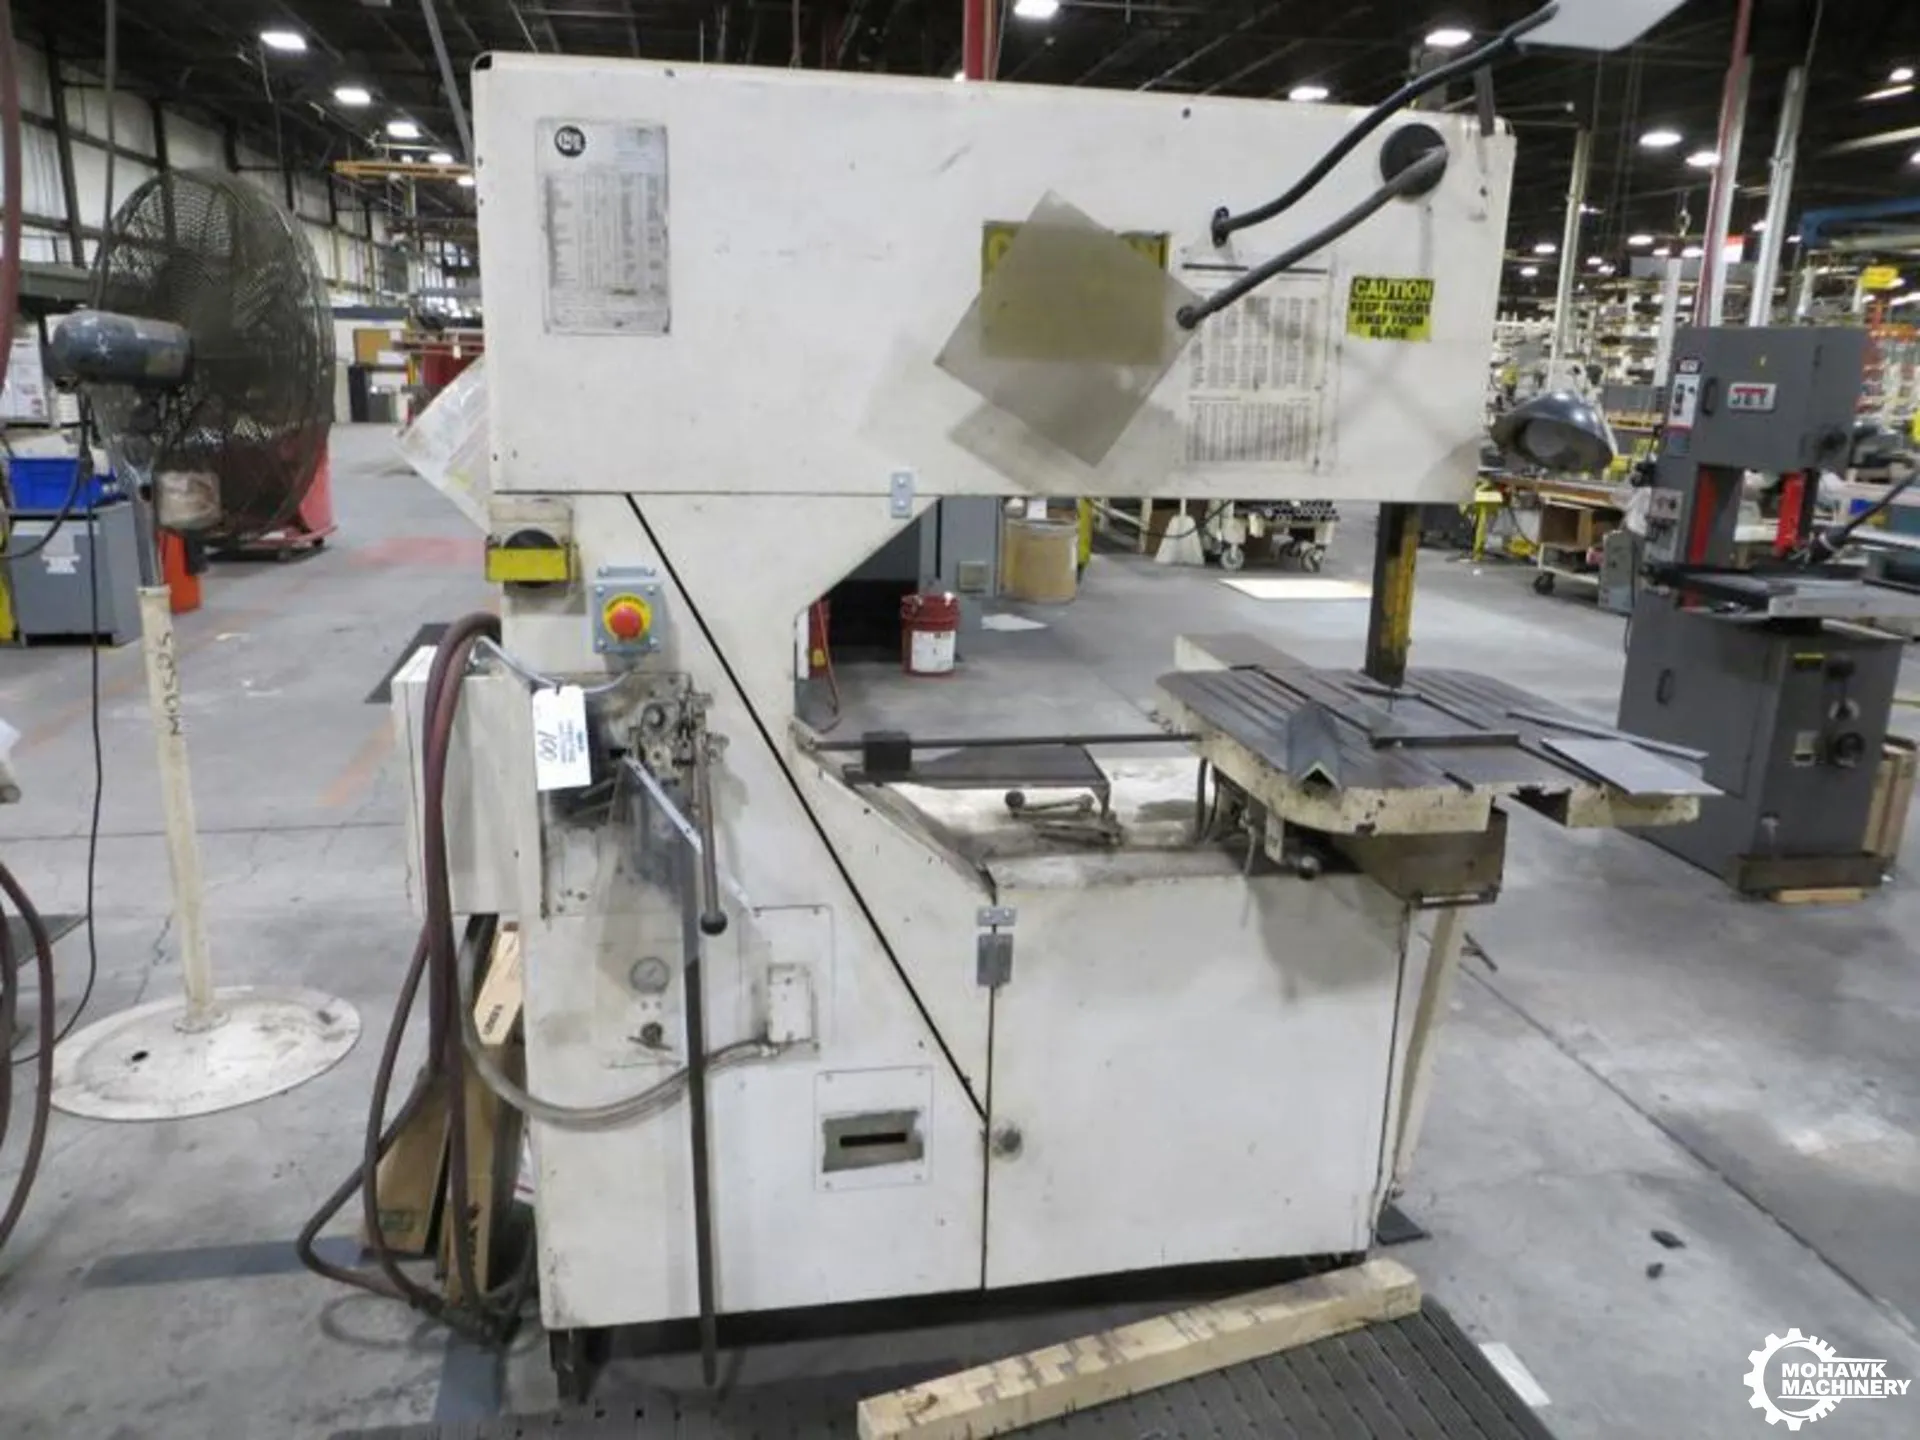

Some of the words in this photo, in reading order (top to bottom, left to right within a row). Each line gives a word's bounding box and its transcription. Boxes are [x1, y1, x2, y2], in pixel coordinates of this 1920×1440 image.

[1354, 281, 1432, 300] CAUTION
[1350, 302, 1379, 314] KEEP
[1730, 386, 1769, 409] JET
